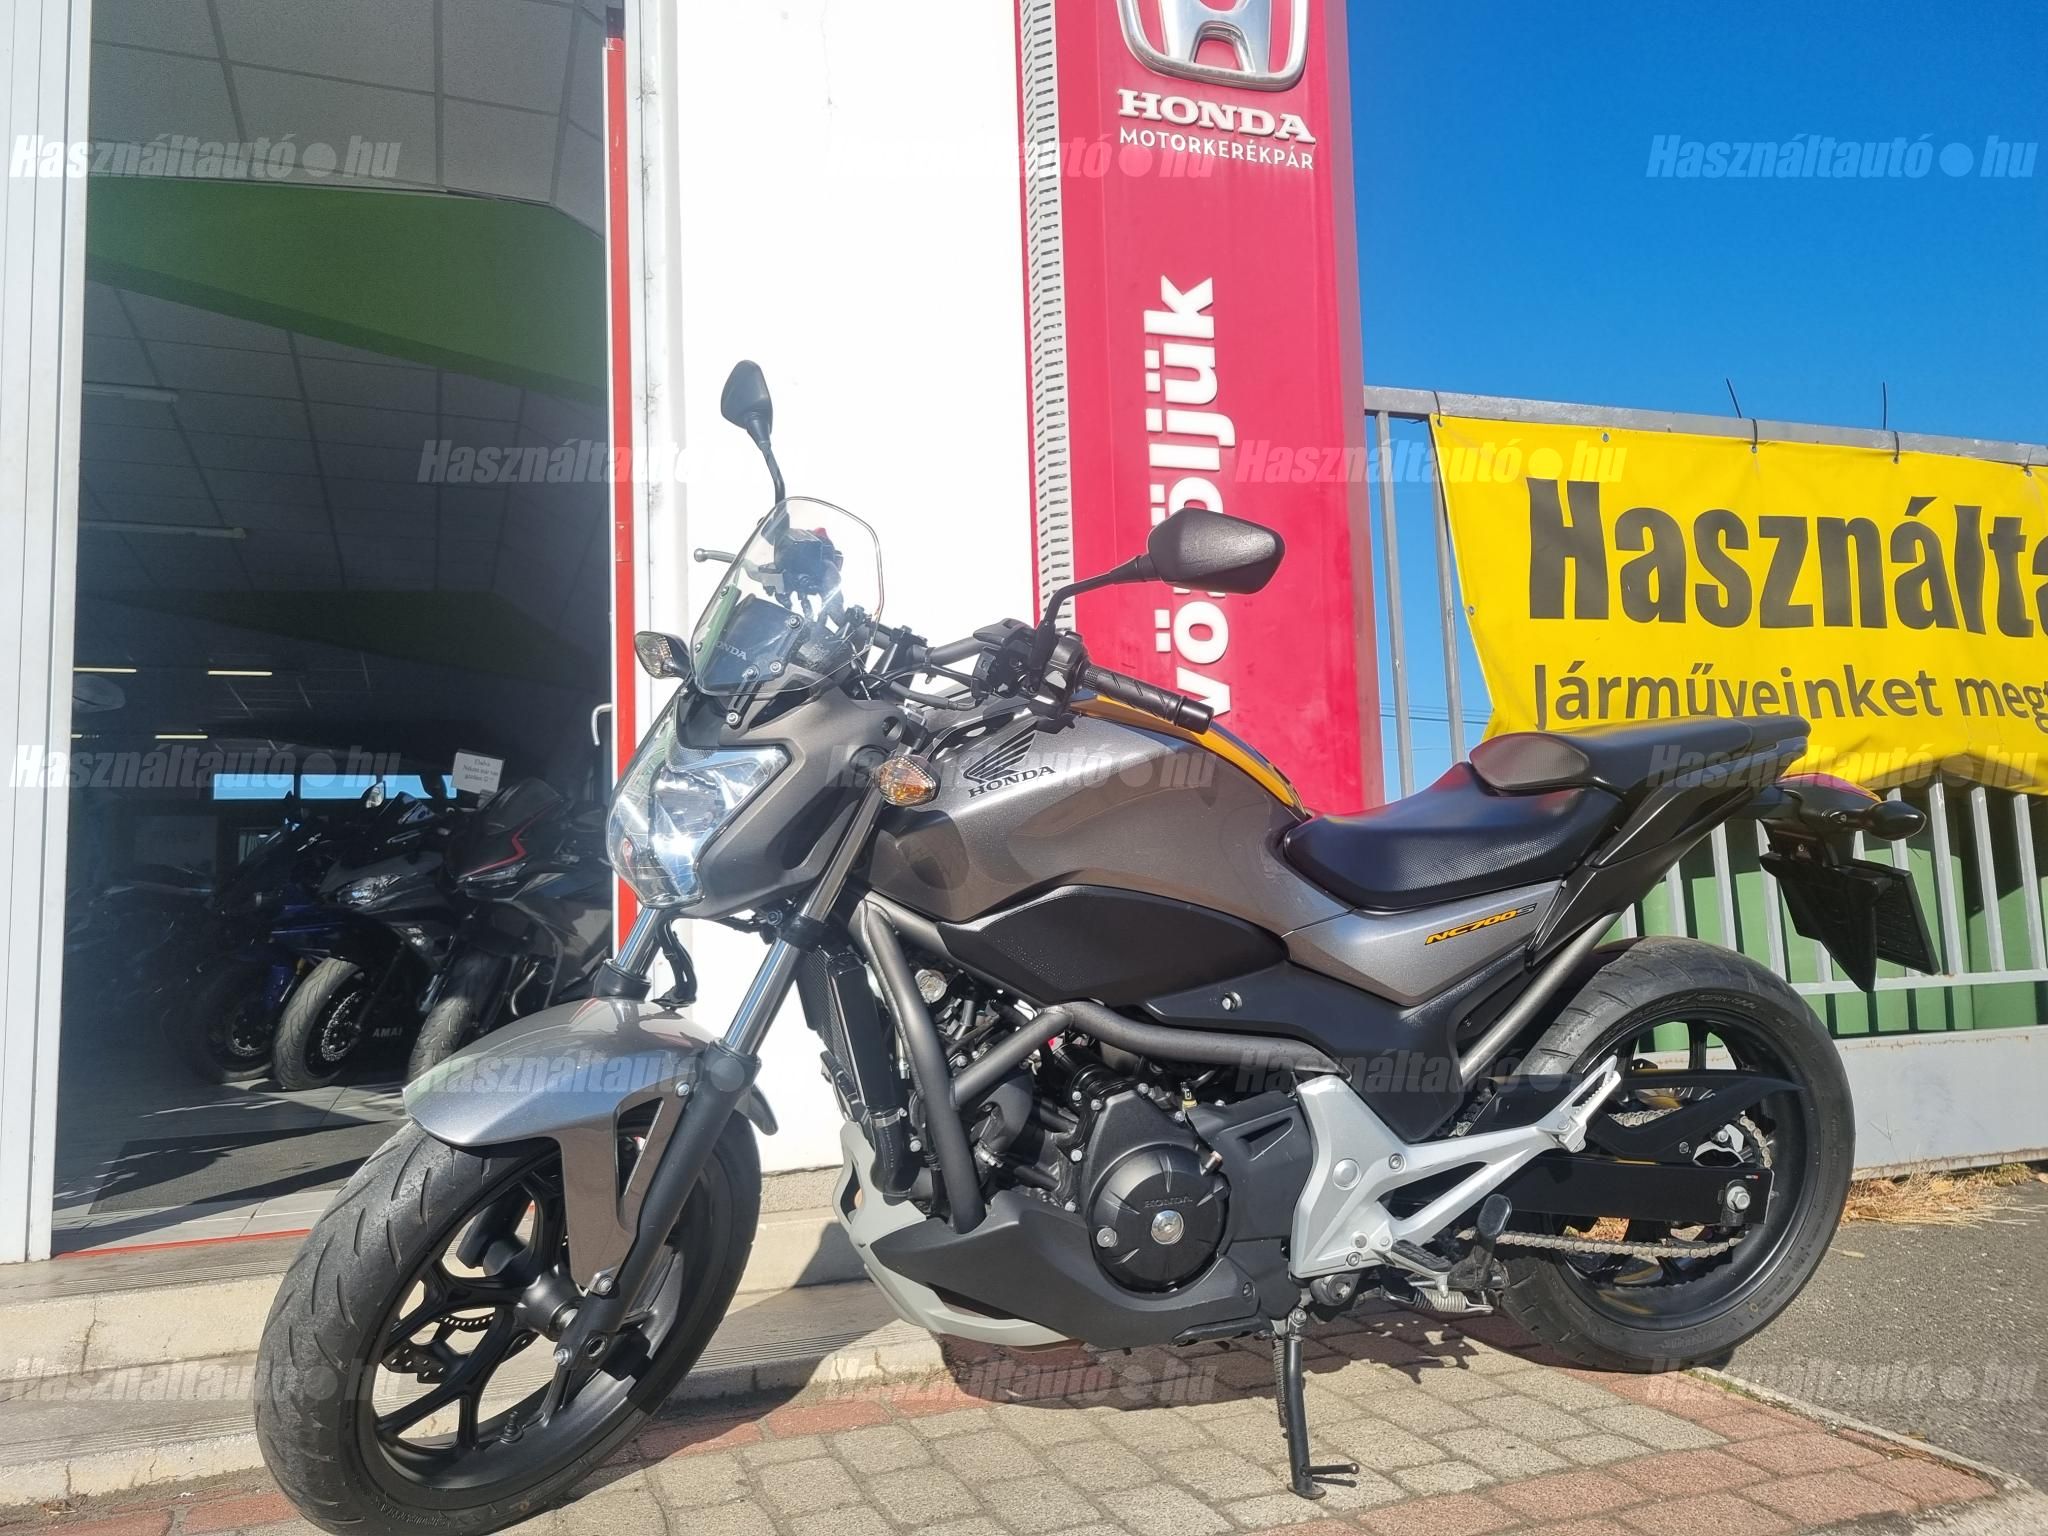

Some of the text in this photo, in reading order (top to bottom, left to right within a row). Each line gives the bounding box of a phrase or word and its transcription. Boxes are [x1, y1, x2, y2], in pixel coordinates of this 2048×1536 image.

[1117, 88, 1316, 144] HONDA
[1119, 126, 1314, 170] MOTORKERÉKPÁR
[1527, 477, 2048, 638] Használt
[1534, 660, 2048, 734] Járműveinket meg
[967, 765, 1057, 798] HONDA
